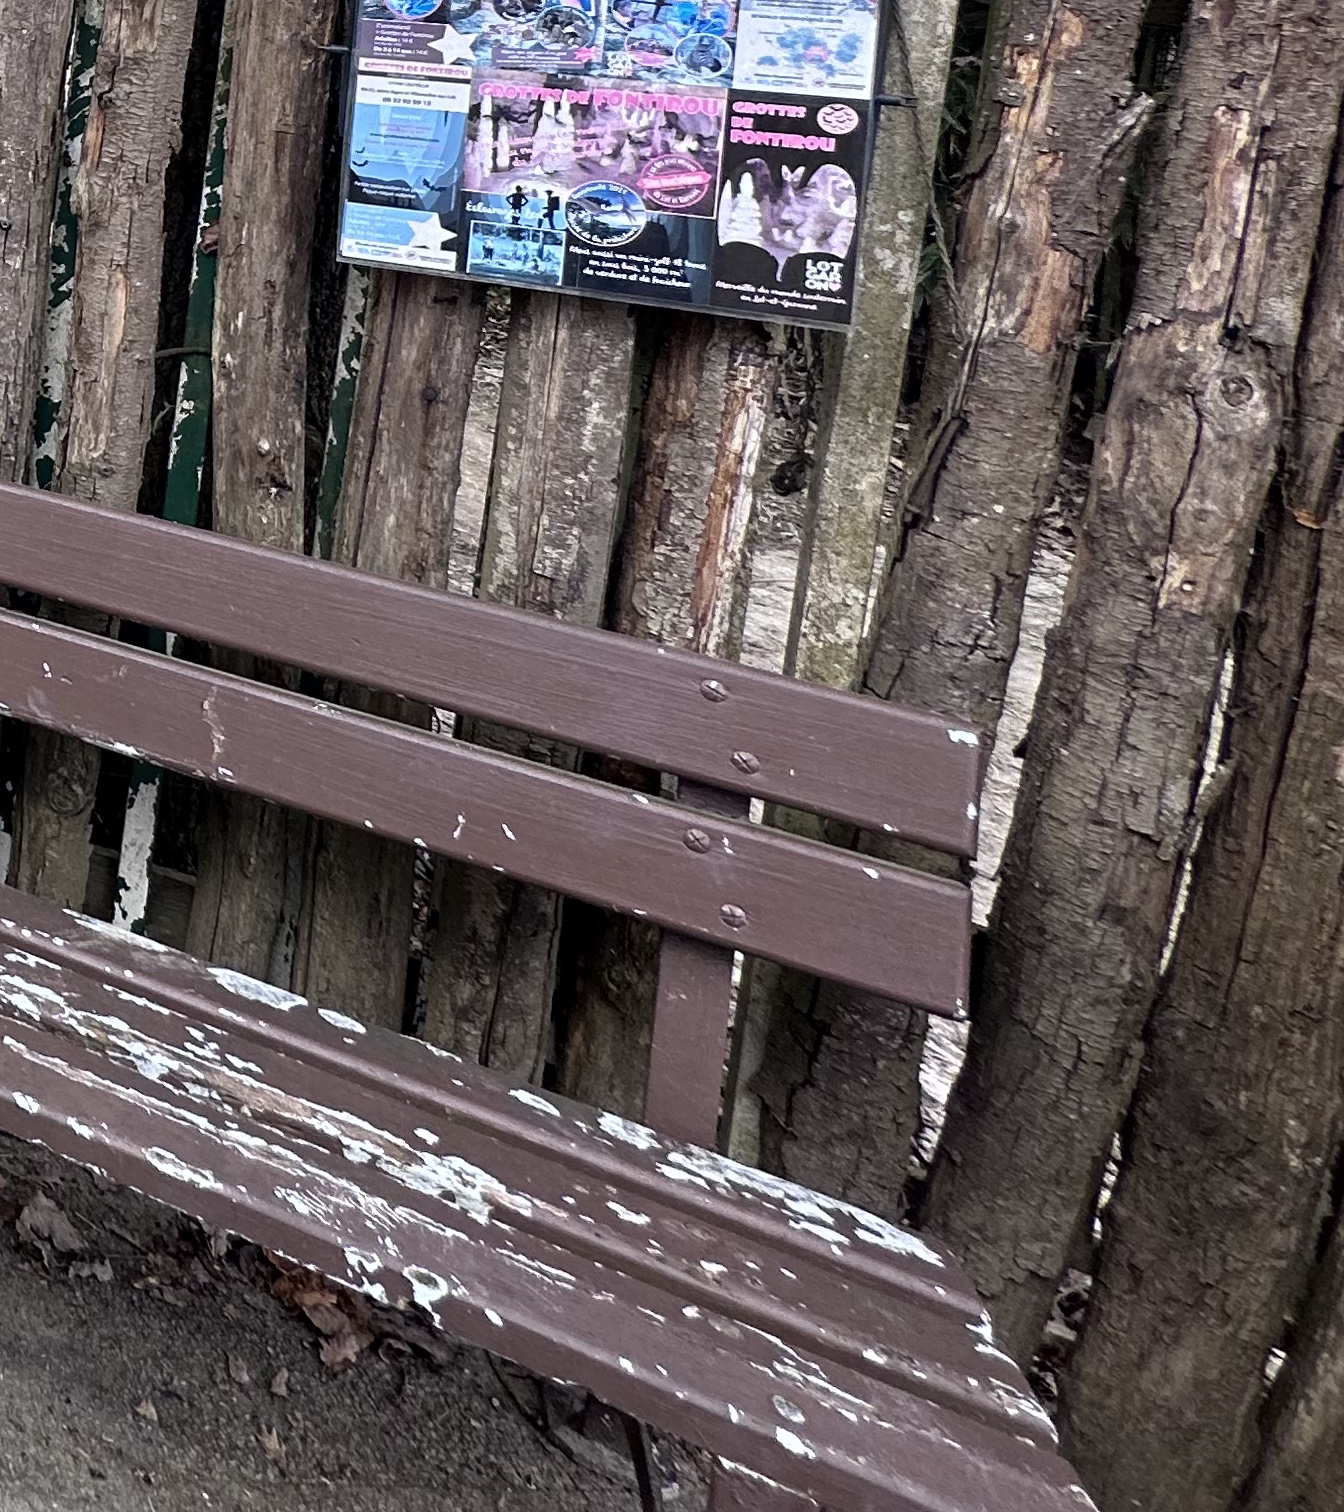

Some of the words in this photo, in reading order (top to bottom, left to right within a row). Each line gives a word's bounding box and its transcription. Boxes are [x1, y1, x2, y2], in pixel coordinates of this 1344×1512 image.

[479, 82, 562, 103] GROTTES
[565, 90, 591, 105] DE
[593, 89, 721, 116] FONTIROU
[732, 101, 807, 118] GROTTES
[730, 116, 754, 129] DE
[729, 129, 836, 152] FONTIROU
[806, 259, 844, 273] LOT
[805, 279, 829, 291] ON
